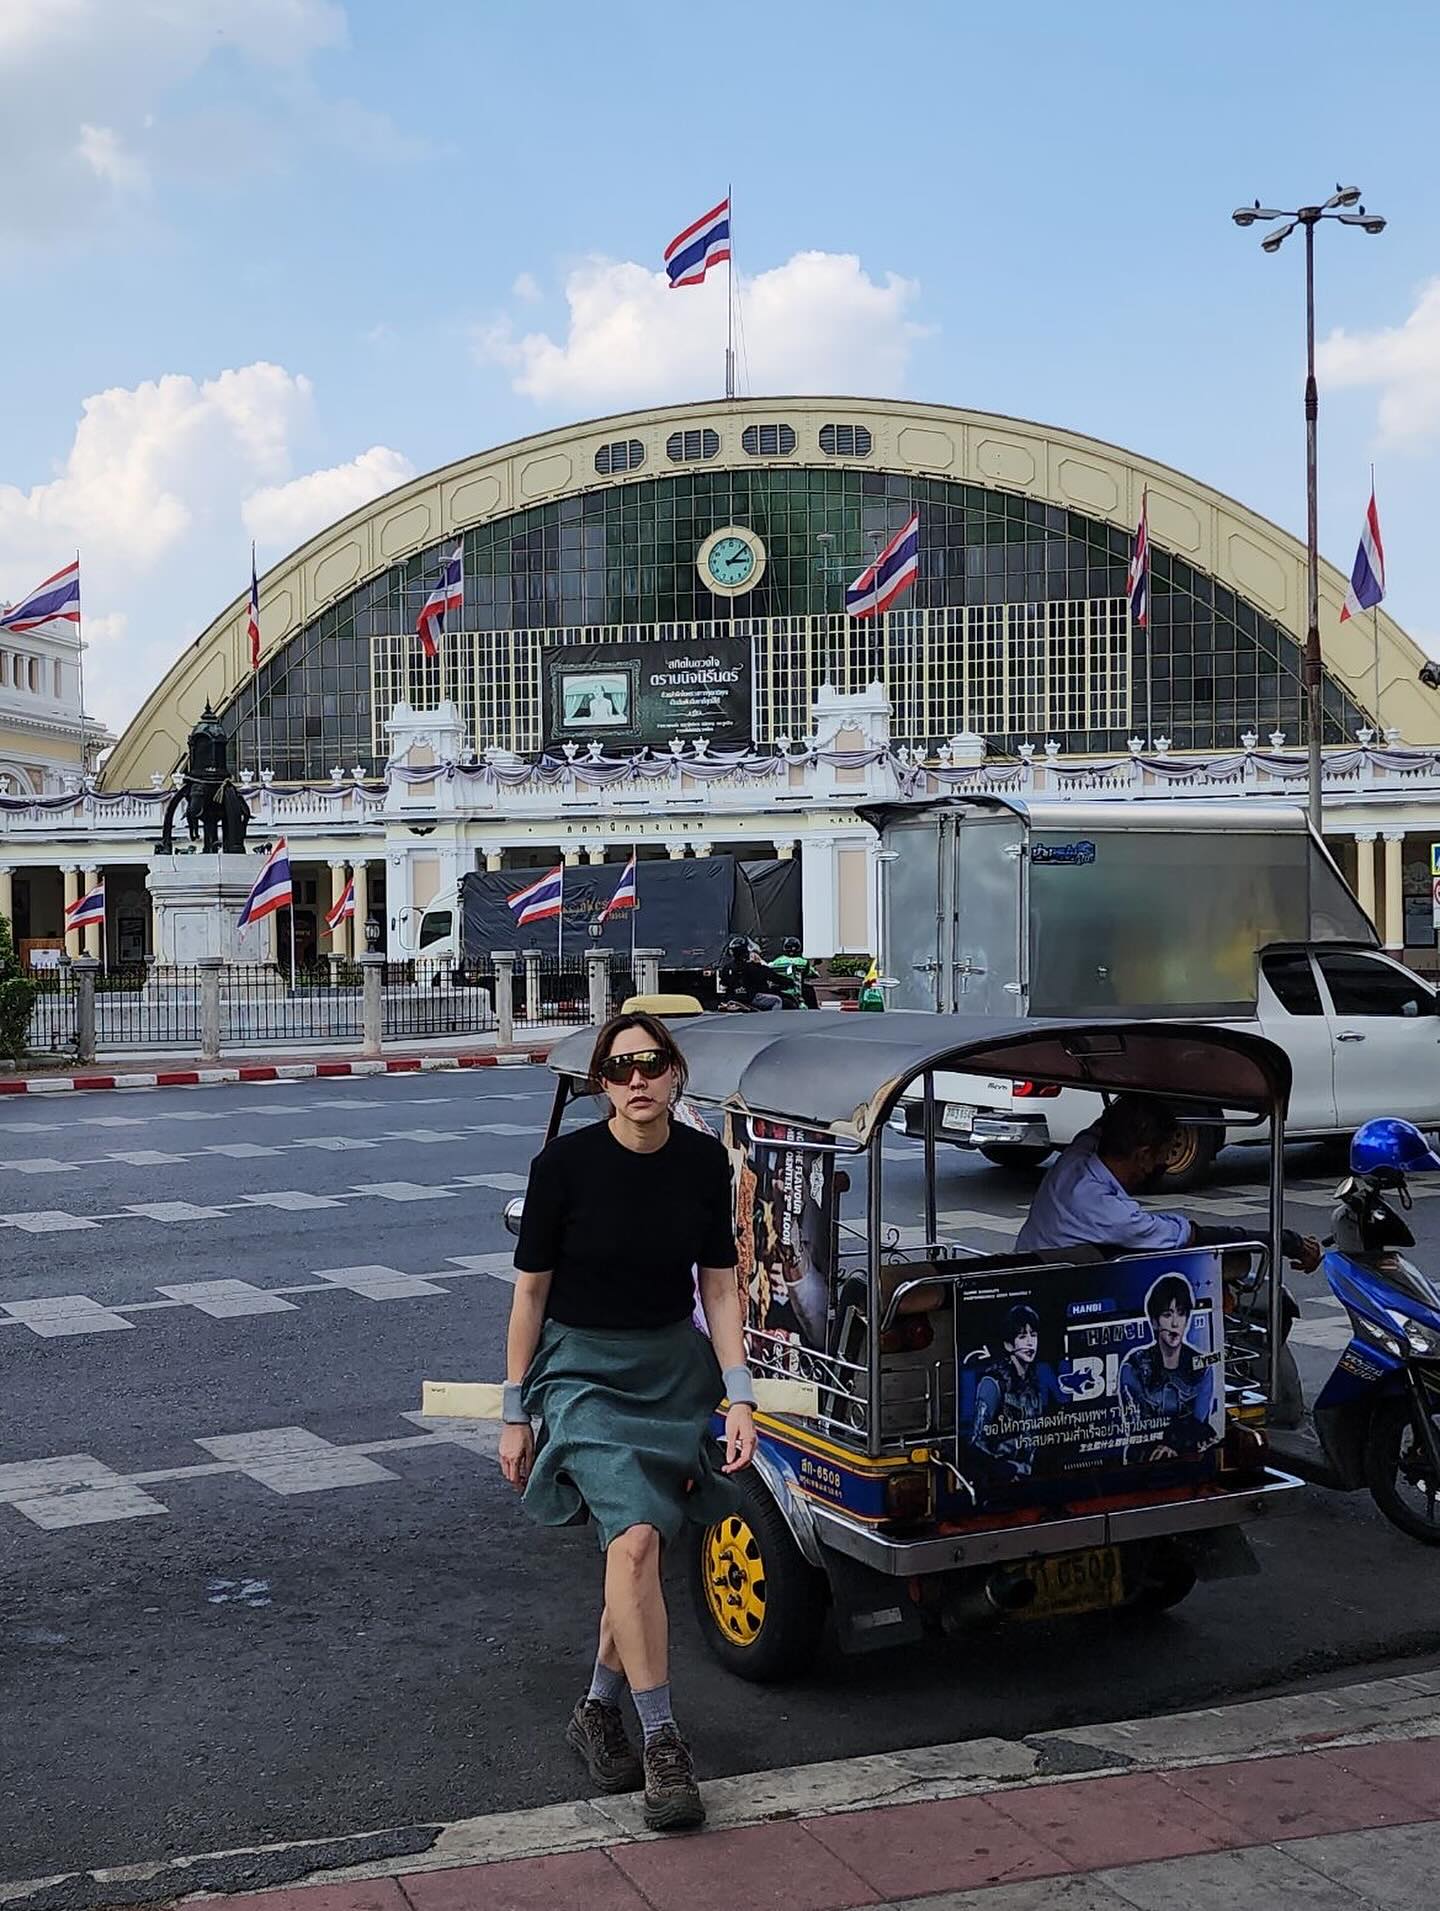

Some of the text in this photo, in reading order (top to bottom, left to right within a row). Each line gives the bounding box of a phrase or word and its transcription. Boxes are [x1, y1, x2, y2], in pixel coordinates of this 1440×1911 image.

[650, 663, 744, 686] ตราบนิจนิรันดร์
[793, 1165, 804, 1215] FLAVOUR
